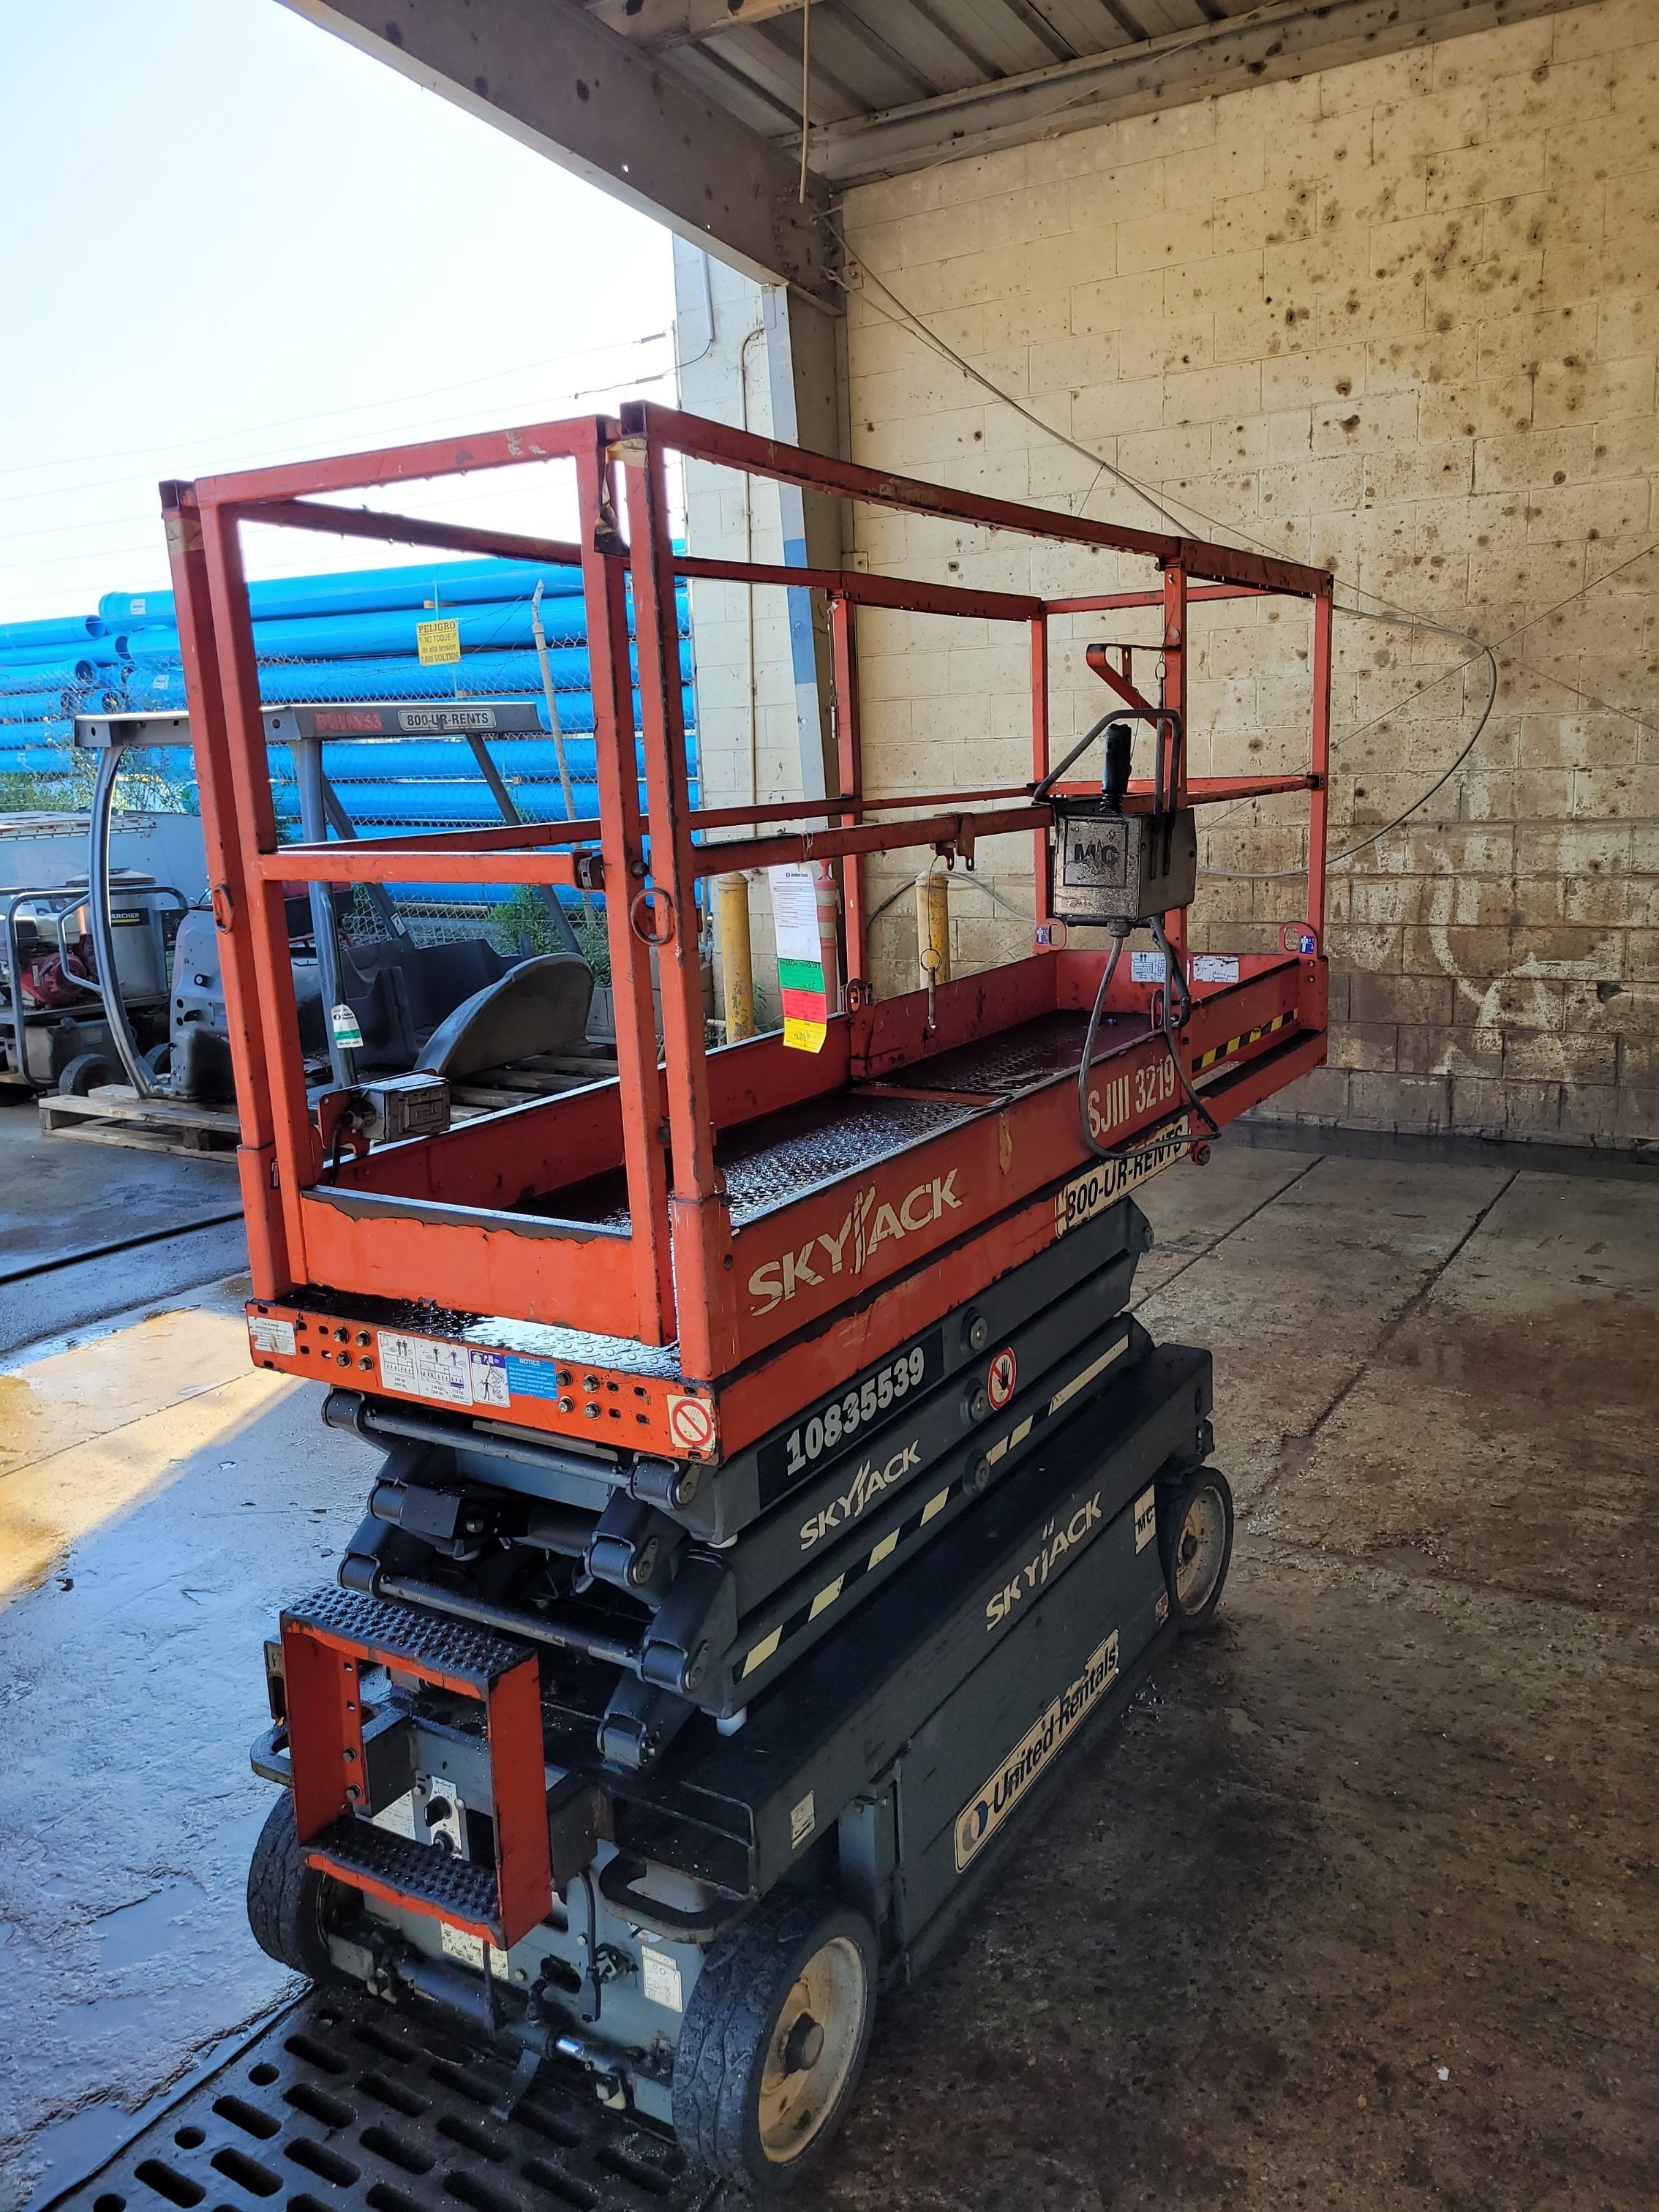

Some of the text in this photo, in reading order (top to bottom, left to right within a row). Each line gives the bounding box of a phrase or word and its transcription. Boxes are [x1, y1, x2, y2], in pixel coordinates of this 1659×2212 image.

[418, 621, 456, 633] PELIGRO
[424, 633, 451, 643] NO TOQUE
[434, 652, 459, 661] VOLTIOS
[407, 712, 489, 726] 800-UR-RENTS
[1135, 1054, 1175, 1113] 3219
[748, 1168, 963, 1316] SKYJACK
[519, 1358, 541, 1366] NOTICE
[786, 1347, 925, 1476] 10835539
[800, 1440, 922, 1550] SKYJACK
[986, 1491, 1102, 1632] SKYJACK
[993, 1646, 1116, 1814] United Rentals
